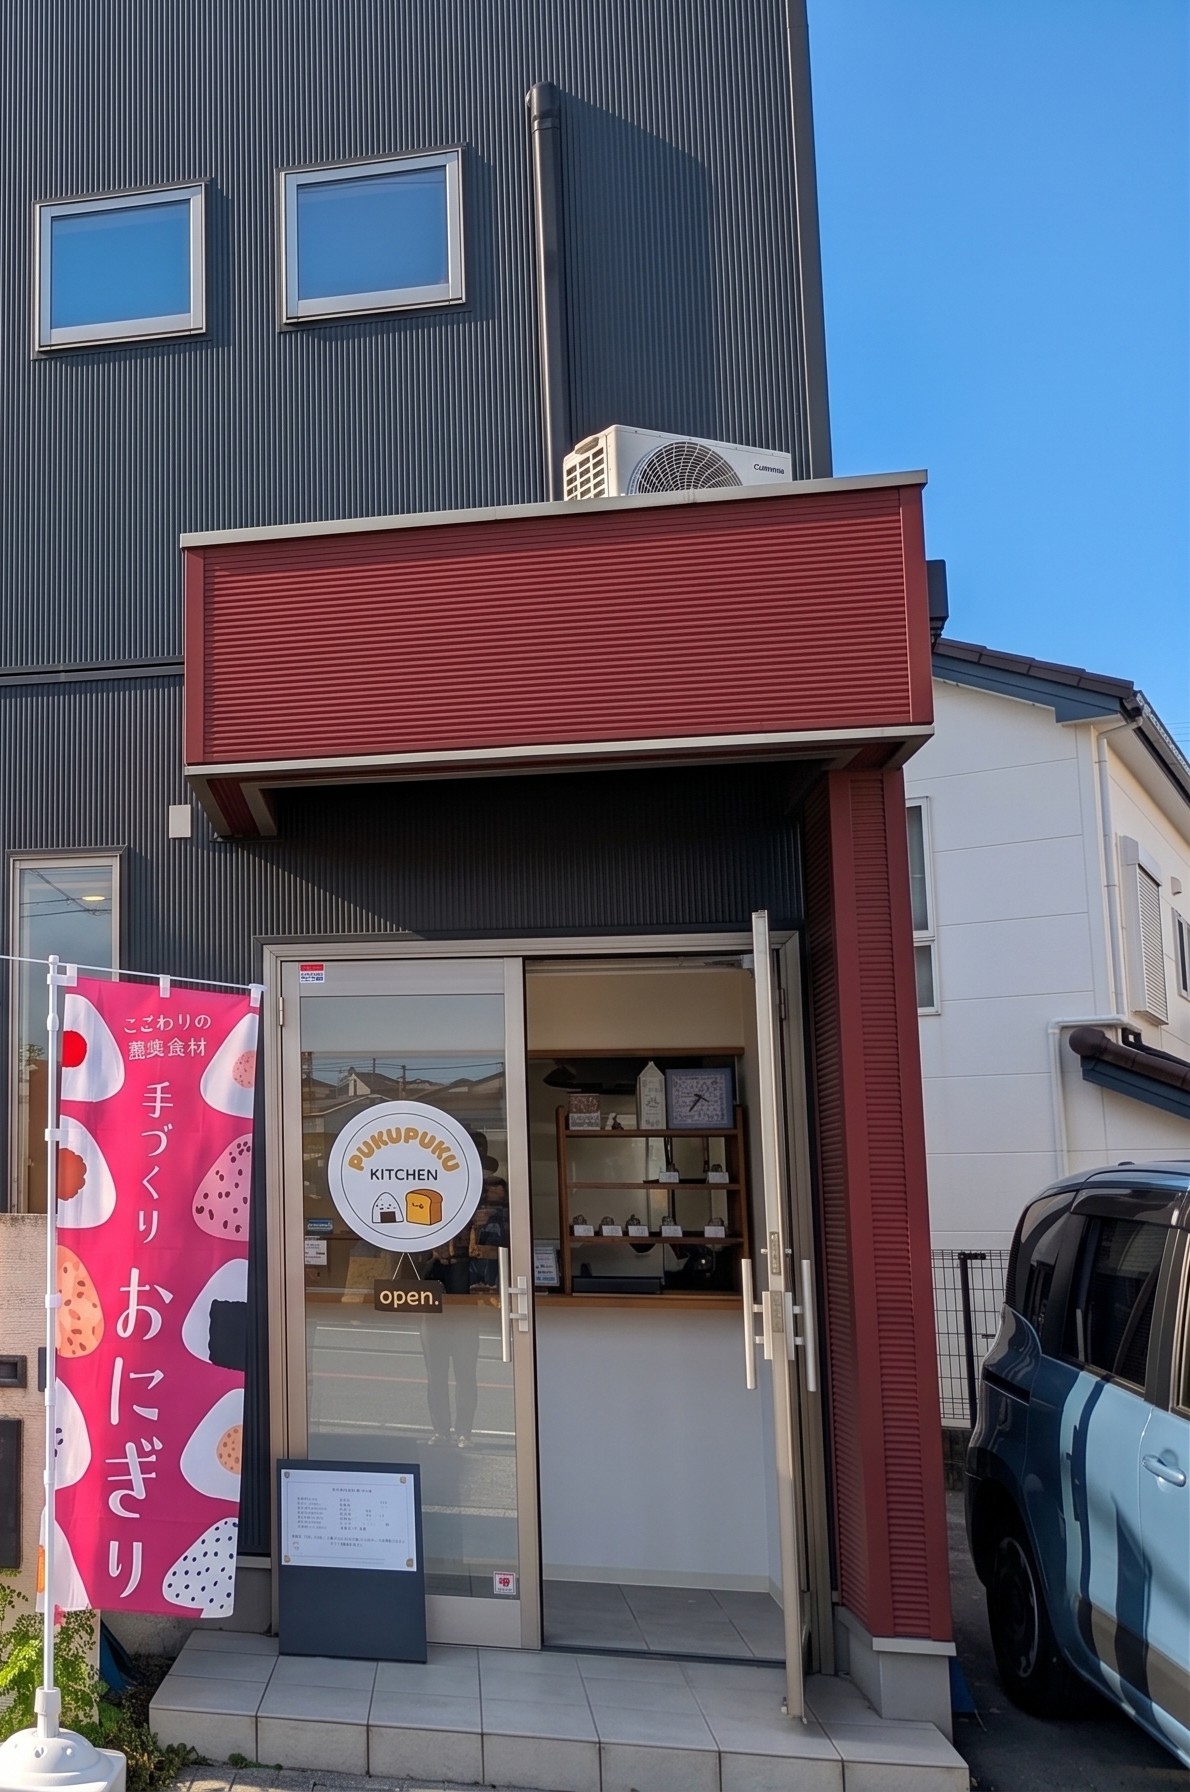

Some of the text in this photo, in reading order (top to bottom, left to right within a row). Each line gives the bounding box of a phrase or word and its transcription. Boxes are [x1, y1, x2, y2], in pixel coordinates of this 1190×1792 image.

[348, 1126, 460, 1172] PUKUPUKU
[370, 1168, 438, 1181] KITCHEN
[105, 1080, 174, 1599] 手づくり おにぎり
